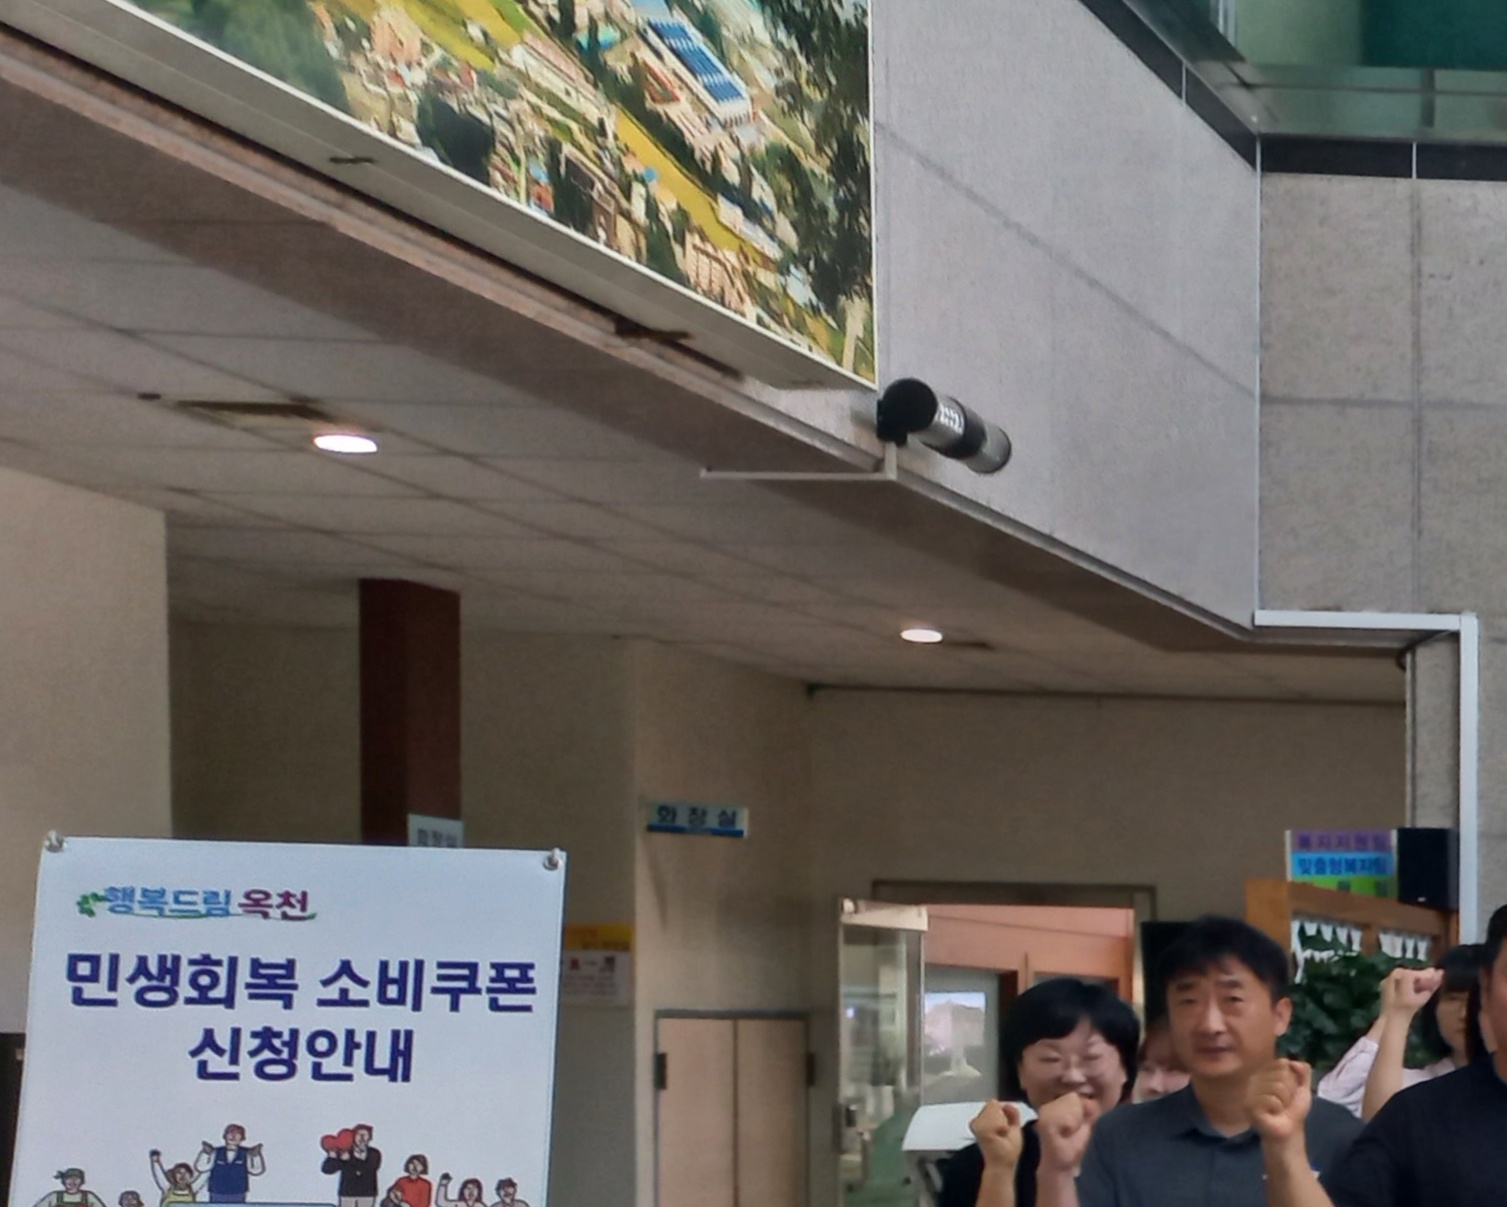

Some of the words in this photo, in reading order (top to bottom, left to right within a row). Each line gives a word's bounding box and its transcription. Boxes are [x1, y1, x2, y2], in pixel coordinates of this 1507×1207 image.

[658, 805, 737, 828] 화장실
[104, 886, 231, 917] 행복드림
[238, 888, 309, 921] 옥천
[65, 952, 299, 1010] 민생회복
[315, 959, 538, 1013] 소비쿠폰
[189, 1026, 415, 1083] 신청안내
